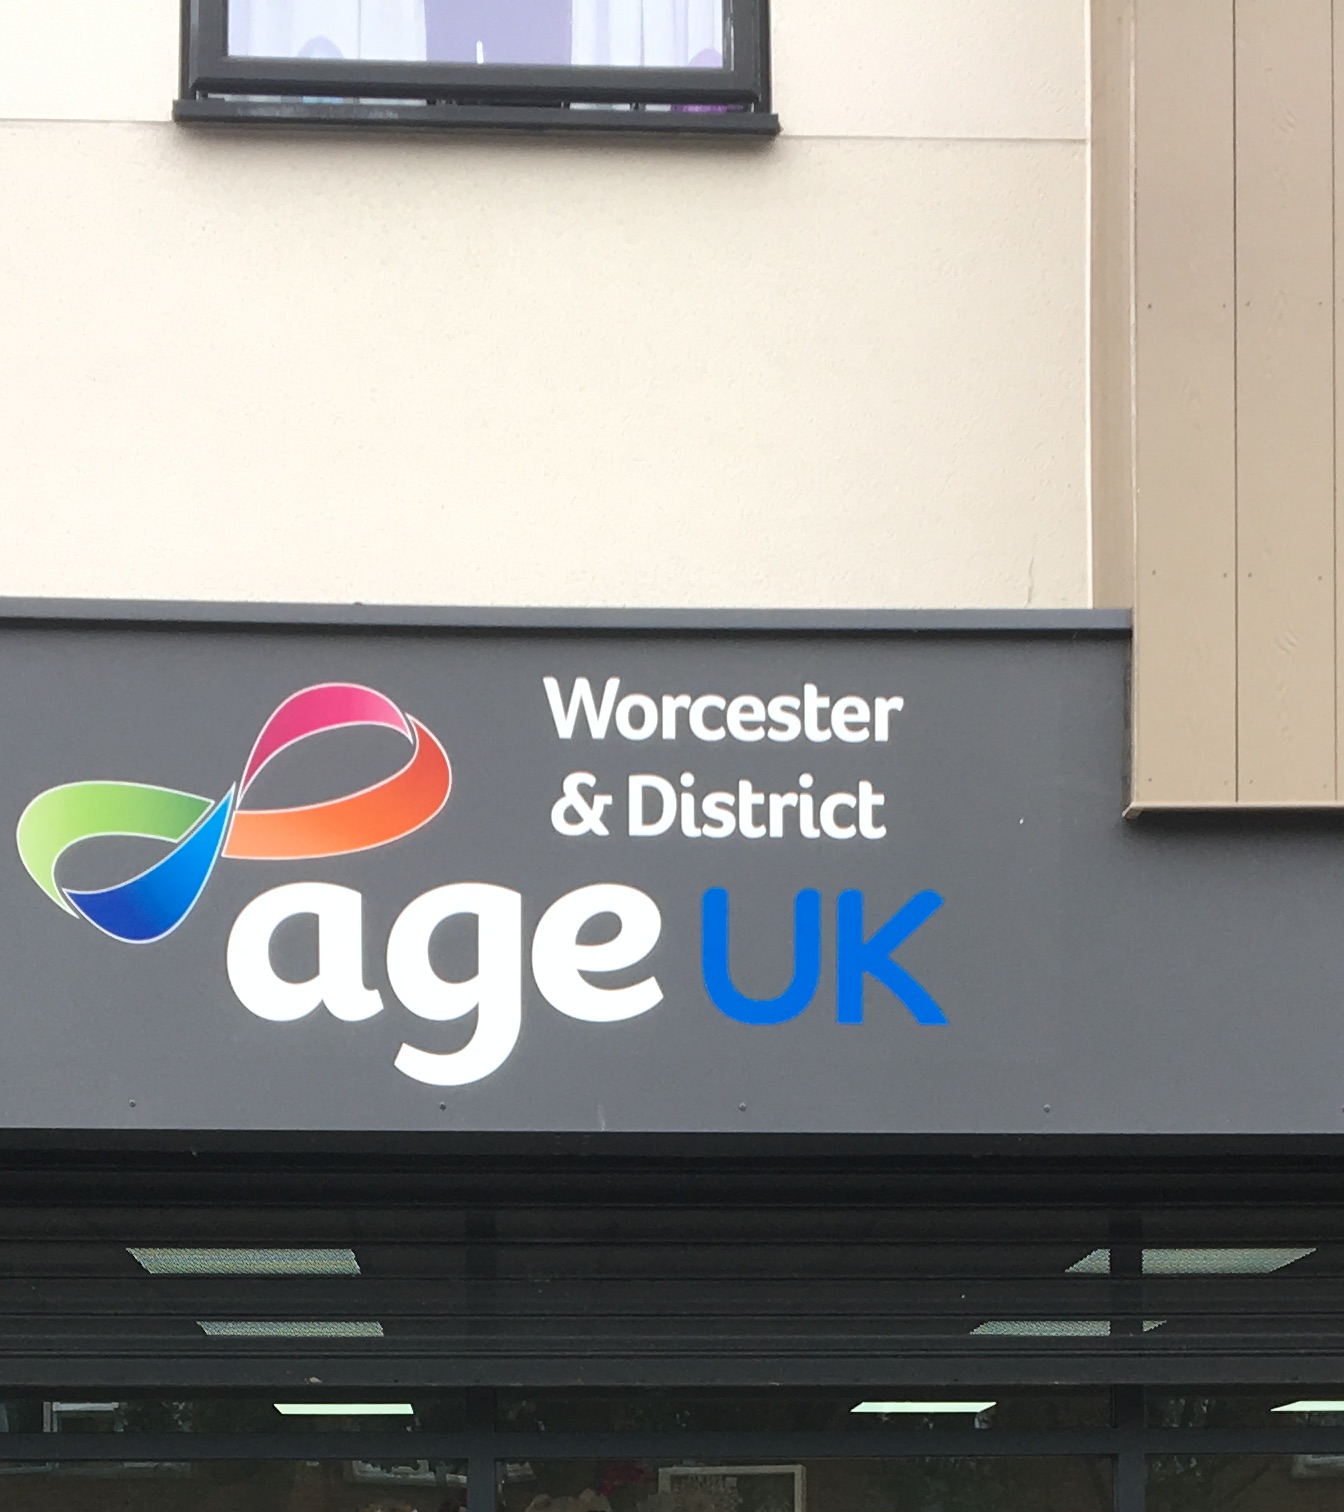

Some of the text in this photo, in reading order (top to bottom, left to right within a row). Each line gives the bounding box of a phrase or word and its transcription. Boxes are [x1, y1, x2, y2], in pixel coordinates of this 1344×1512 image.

[543, 677, 904, 742] Worcester
[550, 773, 888, 839] & District
[226, 881, 948, 1087] age UK
